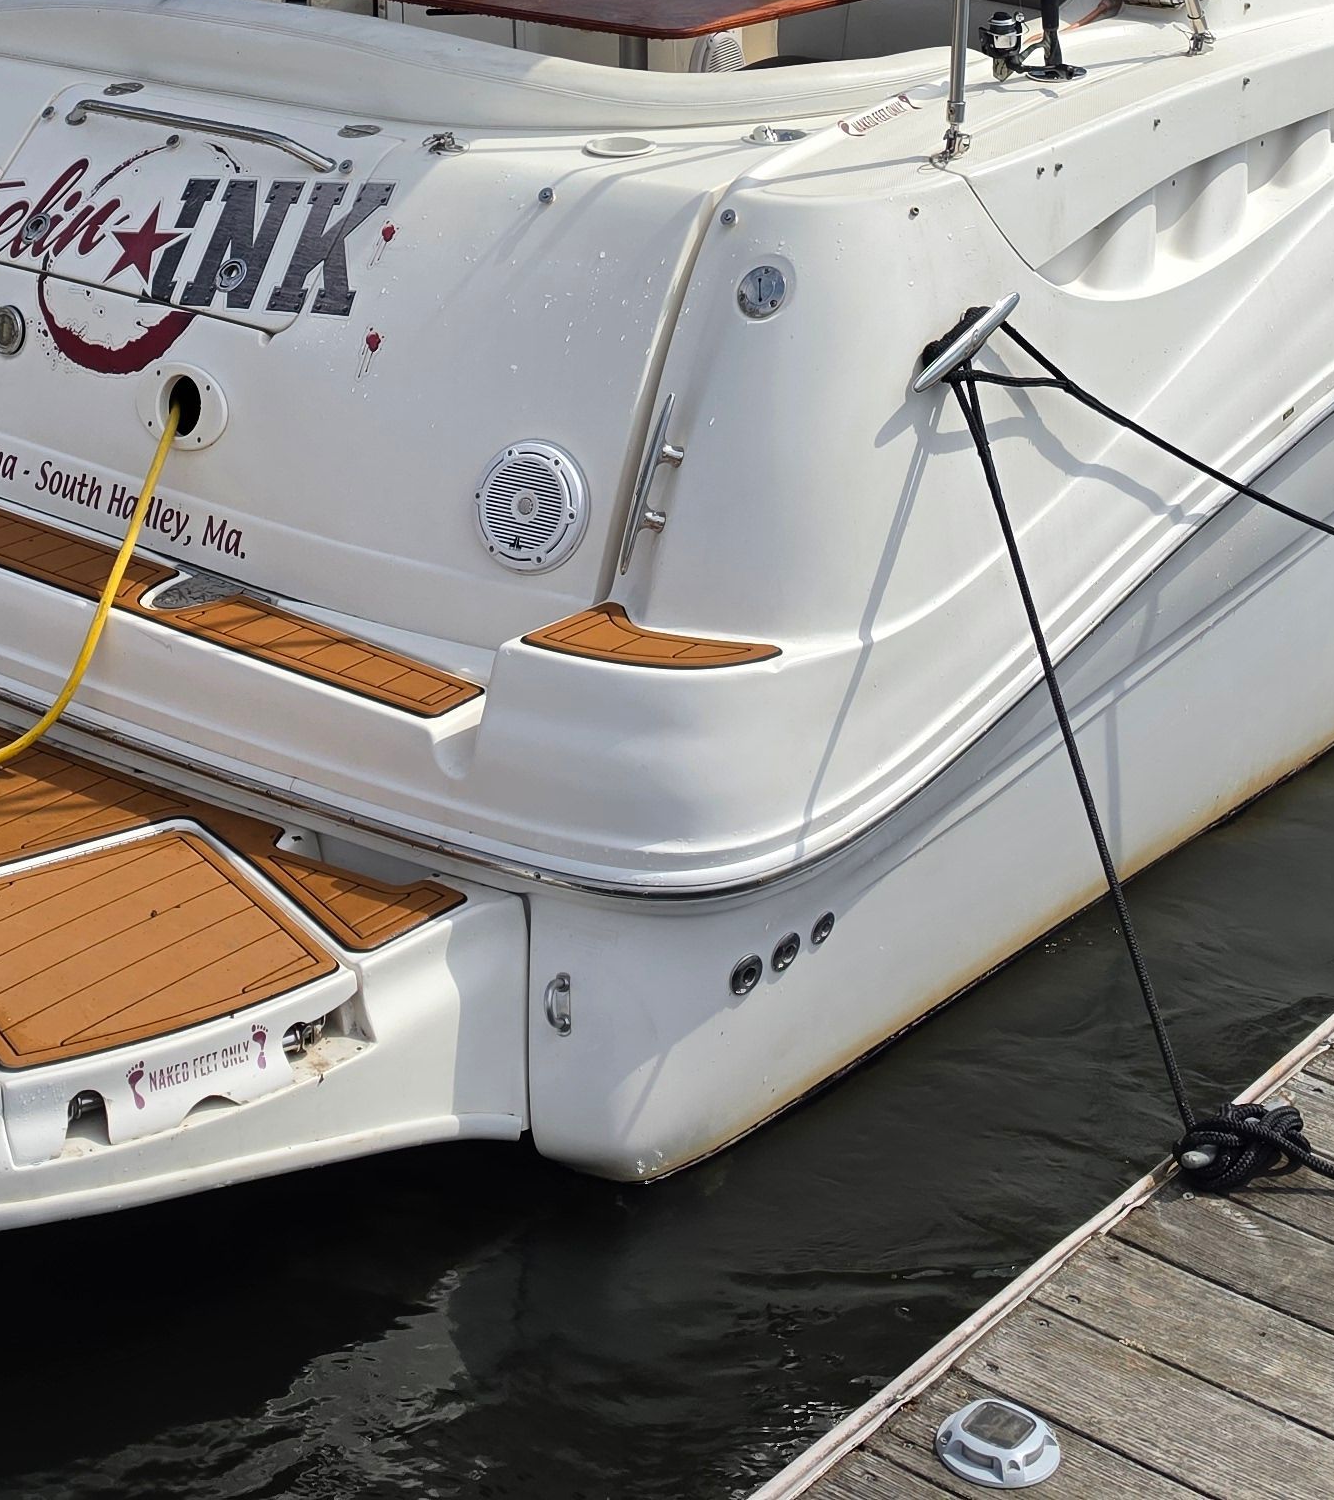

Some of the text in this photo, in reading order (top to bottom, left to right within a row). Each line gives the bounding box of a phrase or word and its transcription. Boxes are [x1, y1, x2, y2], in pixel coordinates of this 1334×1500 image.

[850, 115, 876, 133] NAKED
[138, 178, 395, 317] INK
[34, 460, 101, 510] South
[201, 515, 247, 560] Ma.
[148, 1040, 250, 1093] NAKED FEET ONLY
